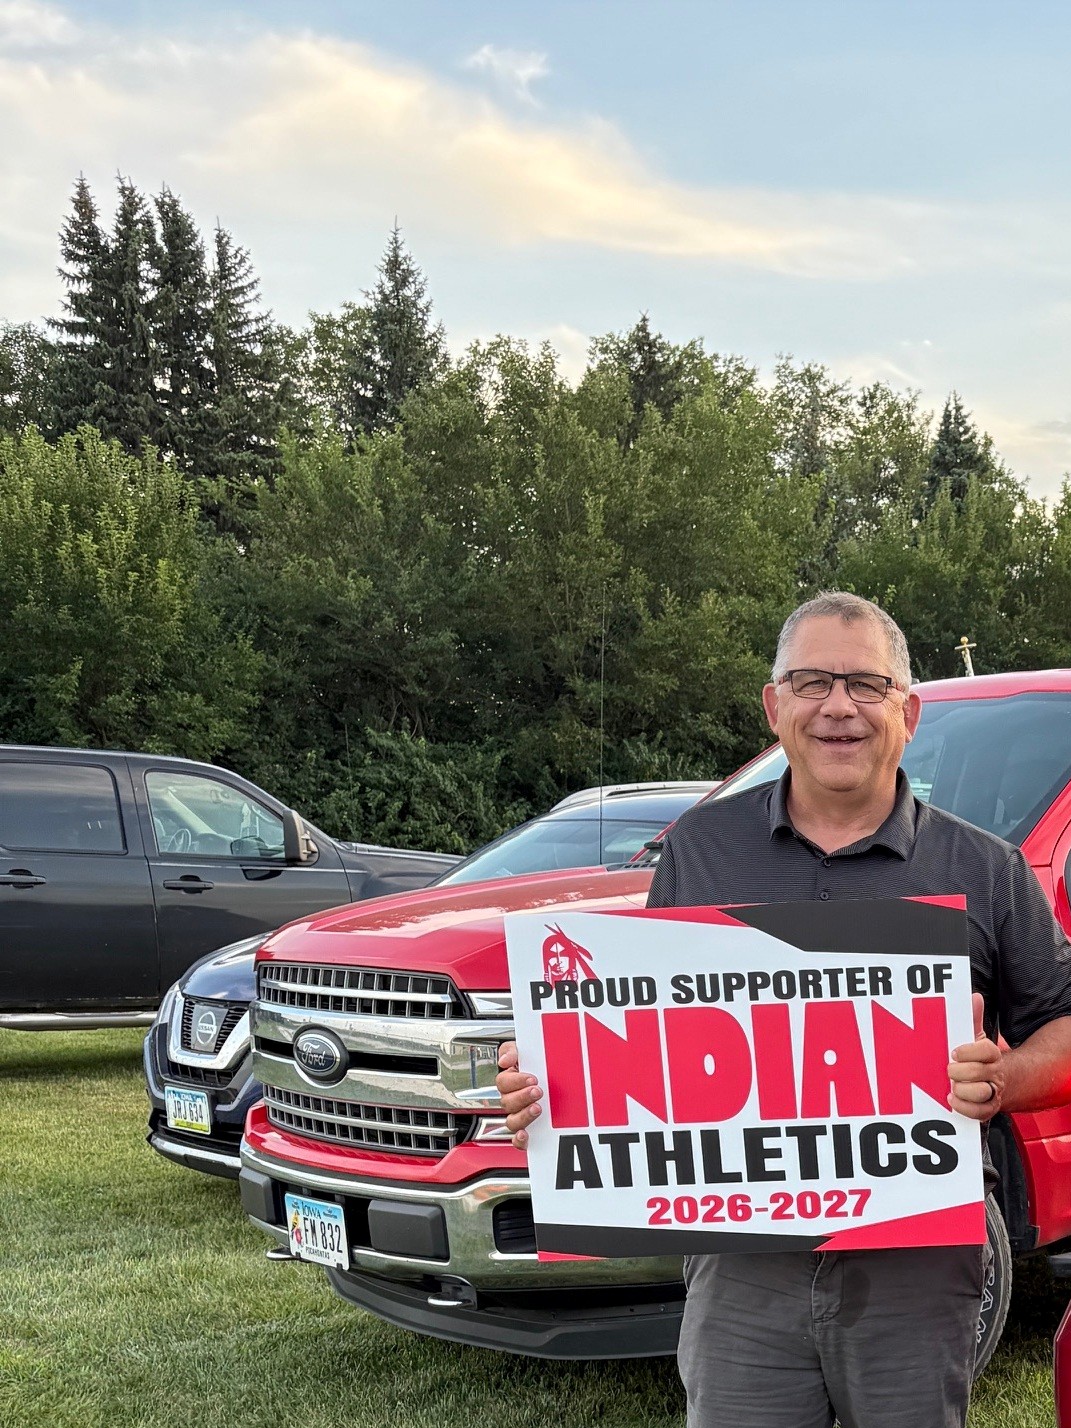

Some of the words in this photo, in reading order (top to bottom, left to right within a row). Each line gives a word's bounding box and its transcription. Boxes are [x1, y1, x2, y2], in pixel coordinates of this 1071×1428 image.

[529, 975, 657, 1011] PROUD
[670, 964, 893, 1004] SUPPORTER
[906, 962, 953, 994] OF
[302, 1042, 326, 1067] Ford
[541, 996, 953, 1128] INDIAN
[555, 1119, 959, 1191] ATHLETICS
[646, 1188, 872, 1226] 2026-2027
[303, 1217, 318, 1247] FM
[320, 1221, 343, 1253] 832
